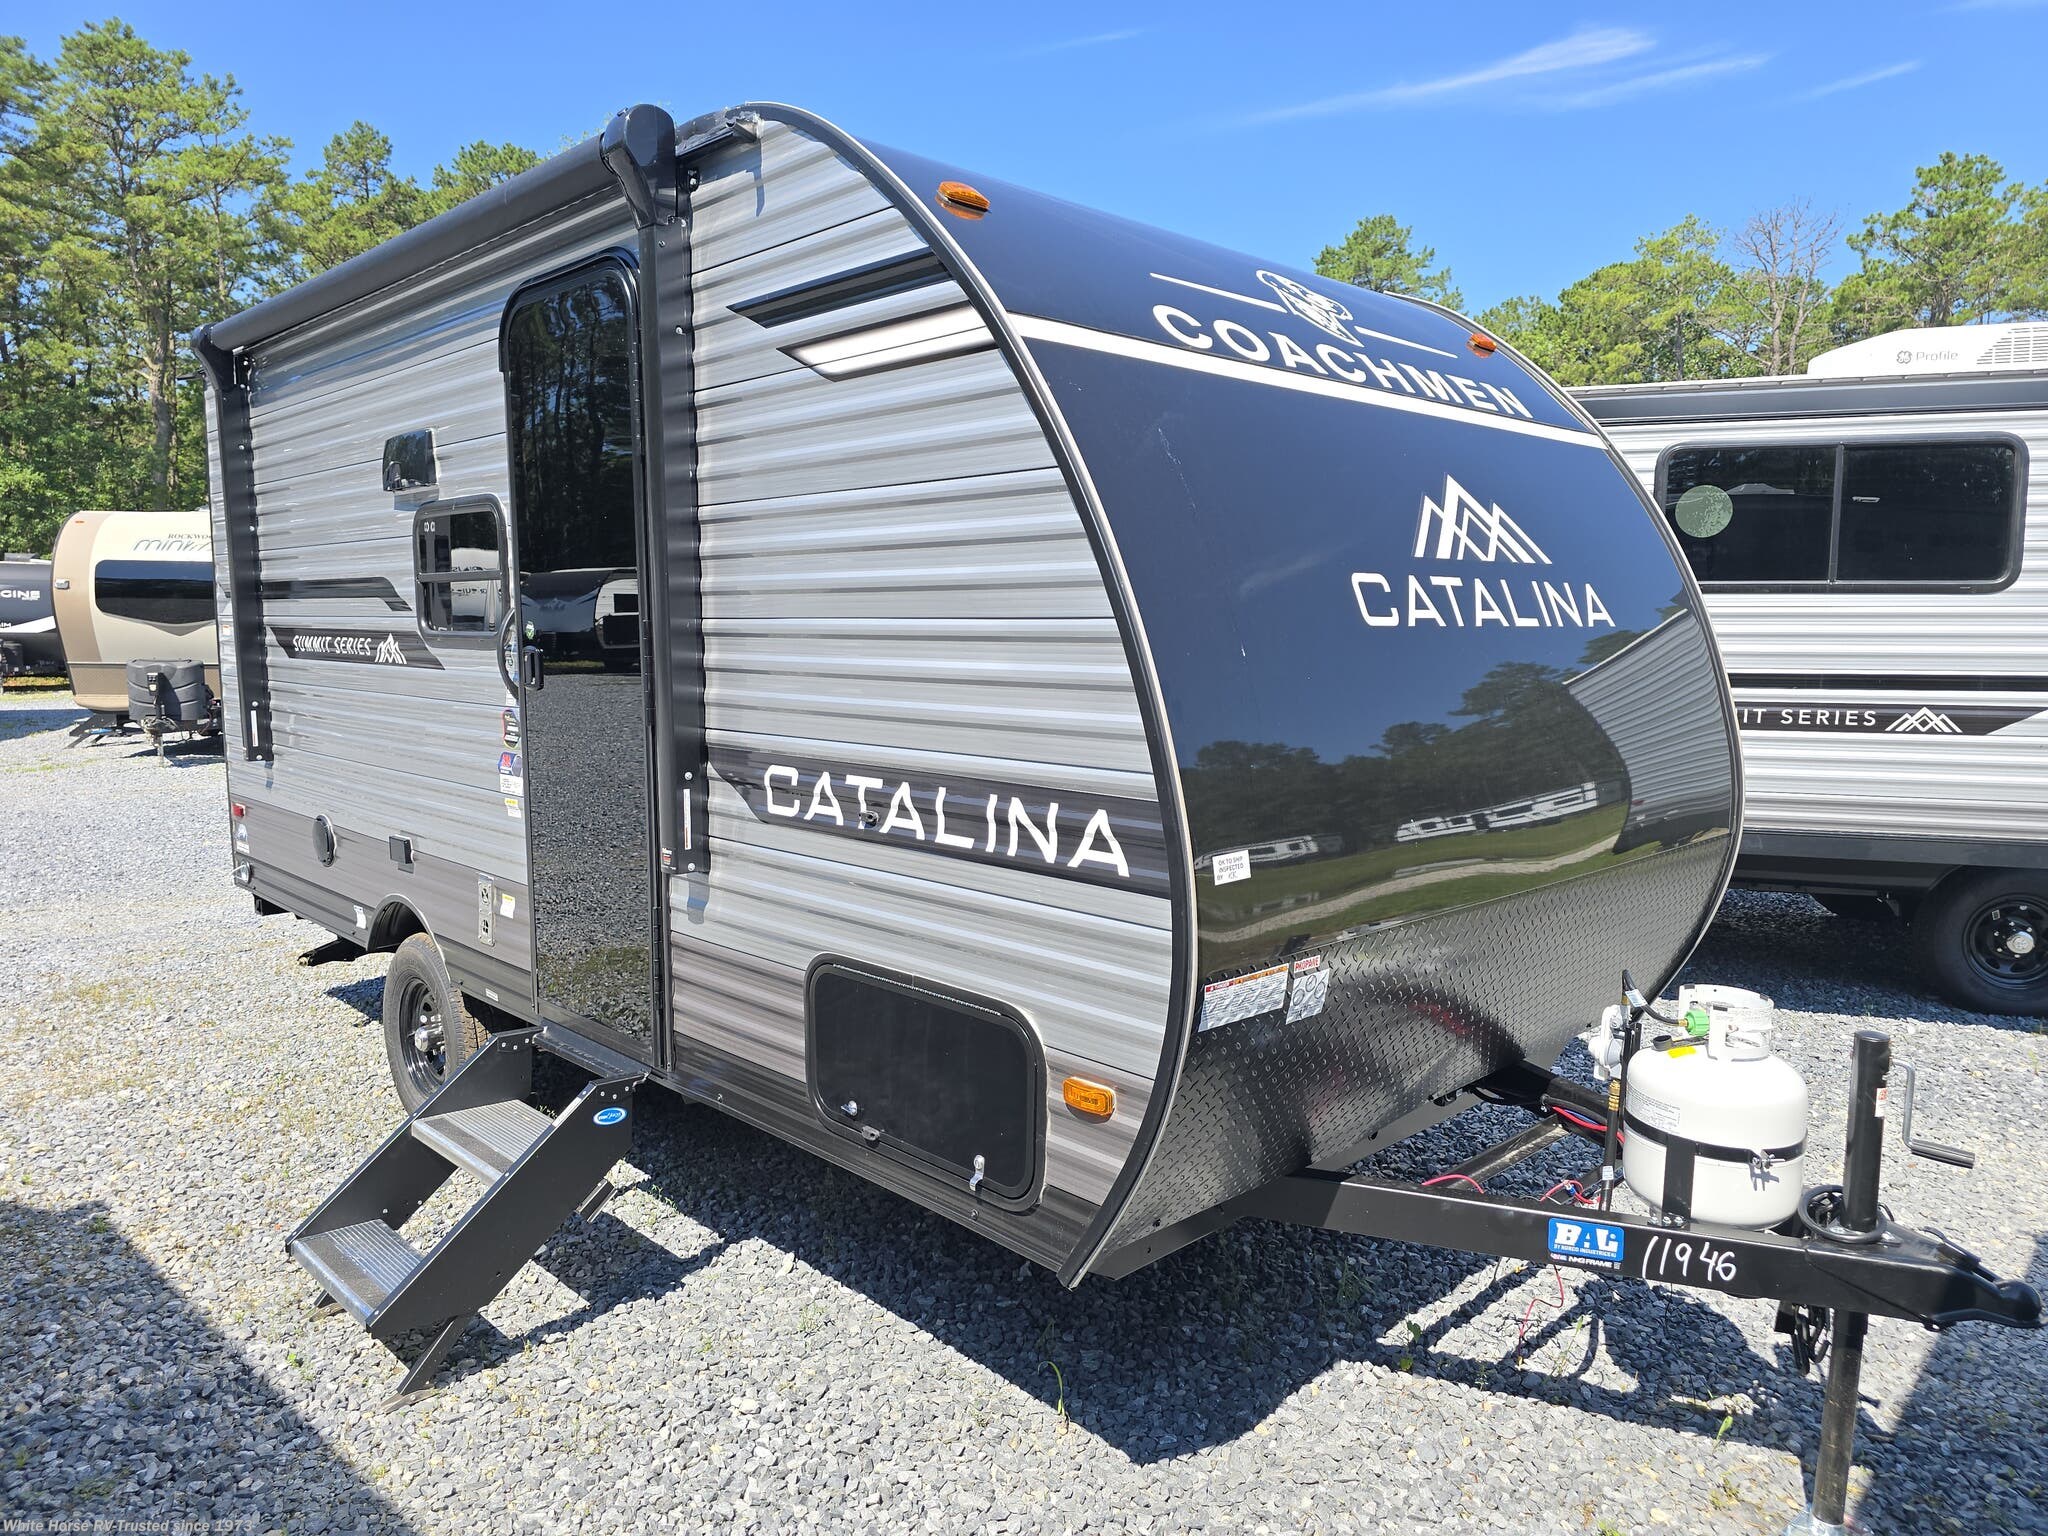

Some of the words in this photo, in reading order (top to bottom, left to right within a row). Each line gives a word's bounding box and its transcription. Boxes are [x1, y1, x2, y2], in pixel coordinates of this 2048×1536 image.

[1152, 304, 1533, 418] COACHMEN
[1915, 351, 1959, 361] Profile
[1351, 572, 1616, 628] CATALINA
[293, 634, 331, 653] SUMMIT
[333, 636, 372, 656] SERIES
[1735, 708, 1767, 724] IT
[1780, 708, 1877, 726] SERIES
[763, 764, 1130, 877] CATALINA
[1295, 956, 1320, 969] PROPANE
[1586, 1258, 1613, 1268] FRAME
[1641, 1235, 1737, 1282] 11946
